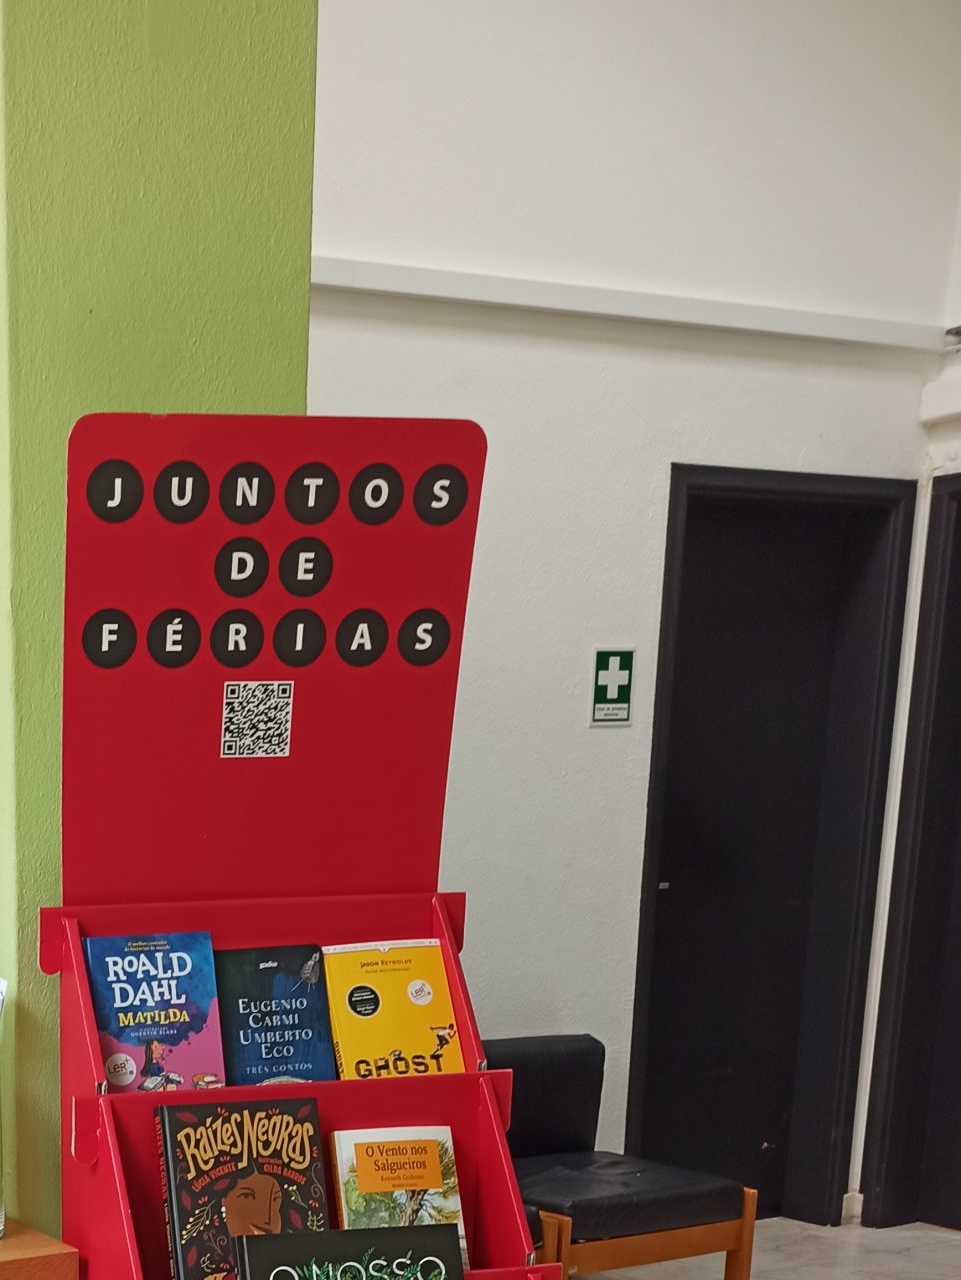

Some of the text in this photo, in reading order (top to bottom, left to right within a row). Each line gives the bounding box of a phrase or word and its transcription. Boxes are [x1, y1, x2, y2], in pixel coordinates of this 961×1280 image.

[107, 477, 451, 509] JUNTOS
[230, 551, 315, 581] DE
[101, 618, 434, 652] FÉRIAS
[105, 951, 193, 982] ROALD
[111, 979, 187, 1008] DAHL
[118, 1008, 190, 1027] MATILDA
[246, 1062, 313, 1075] TRÊS CONTOS
[355, 1053, 444, 1079] GHOST
[365, 1144, 429, 1158] O Vento nos
[191, 1162, 237, 1192] LÚCIA VICENTE
[263, 1164, 307, 1185] GILDA BARROS
[373, 1158, 427, 1174] Salgueiros
